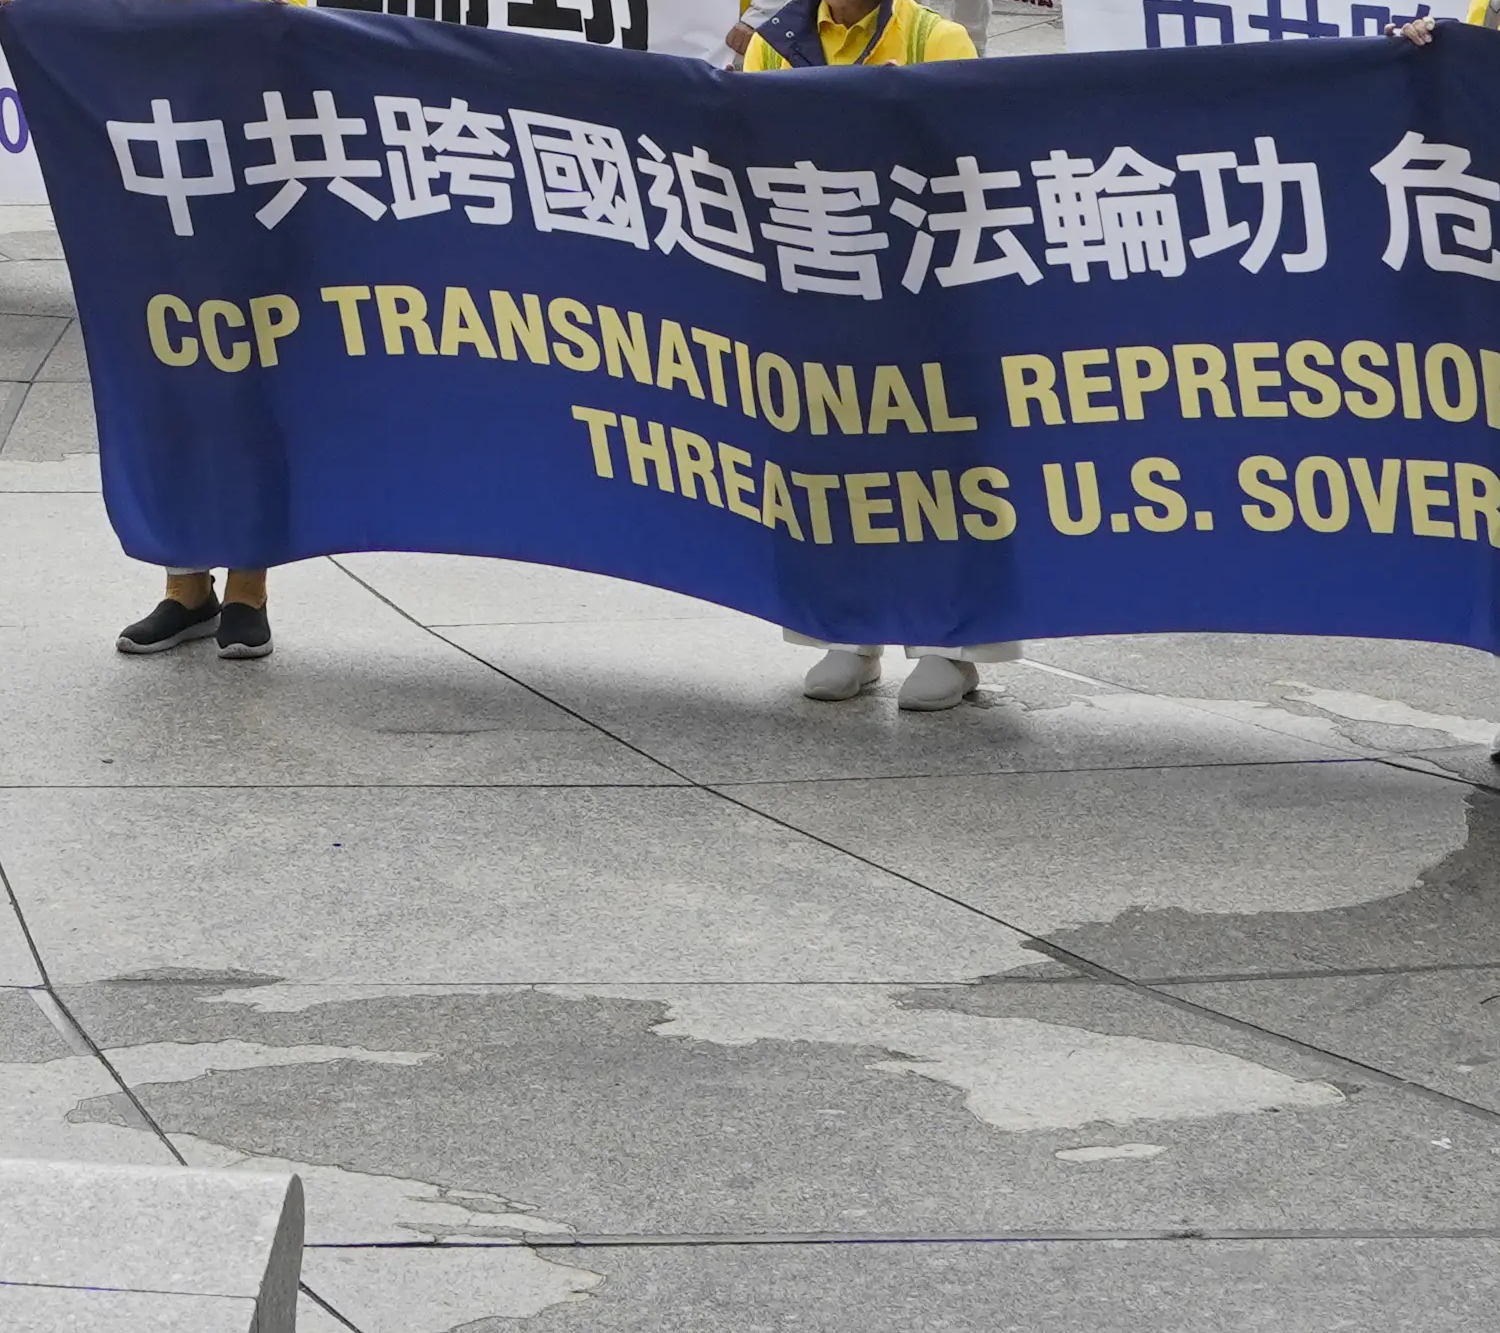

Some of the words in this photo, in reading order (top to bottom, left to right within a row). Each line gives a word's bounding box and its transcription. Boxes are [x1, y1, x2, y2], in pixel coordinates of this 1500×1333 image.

[106, 89, 1329, 301] 中共跨國迫害法輪功
[147, 293, 300, 373] CCP
[321, 285, 976, 435] TRANSNATIONAL
[571, 406, 1016, 545] THREATENS
[1043, 458, 1212, 534] U.S.
